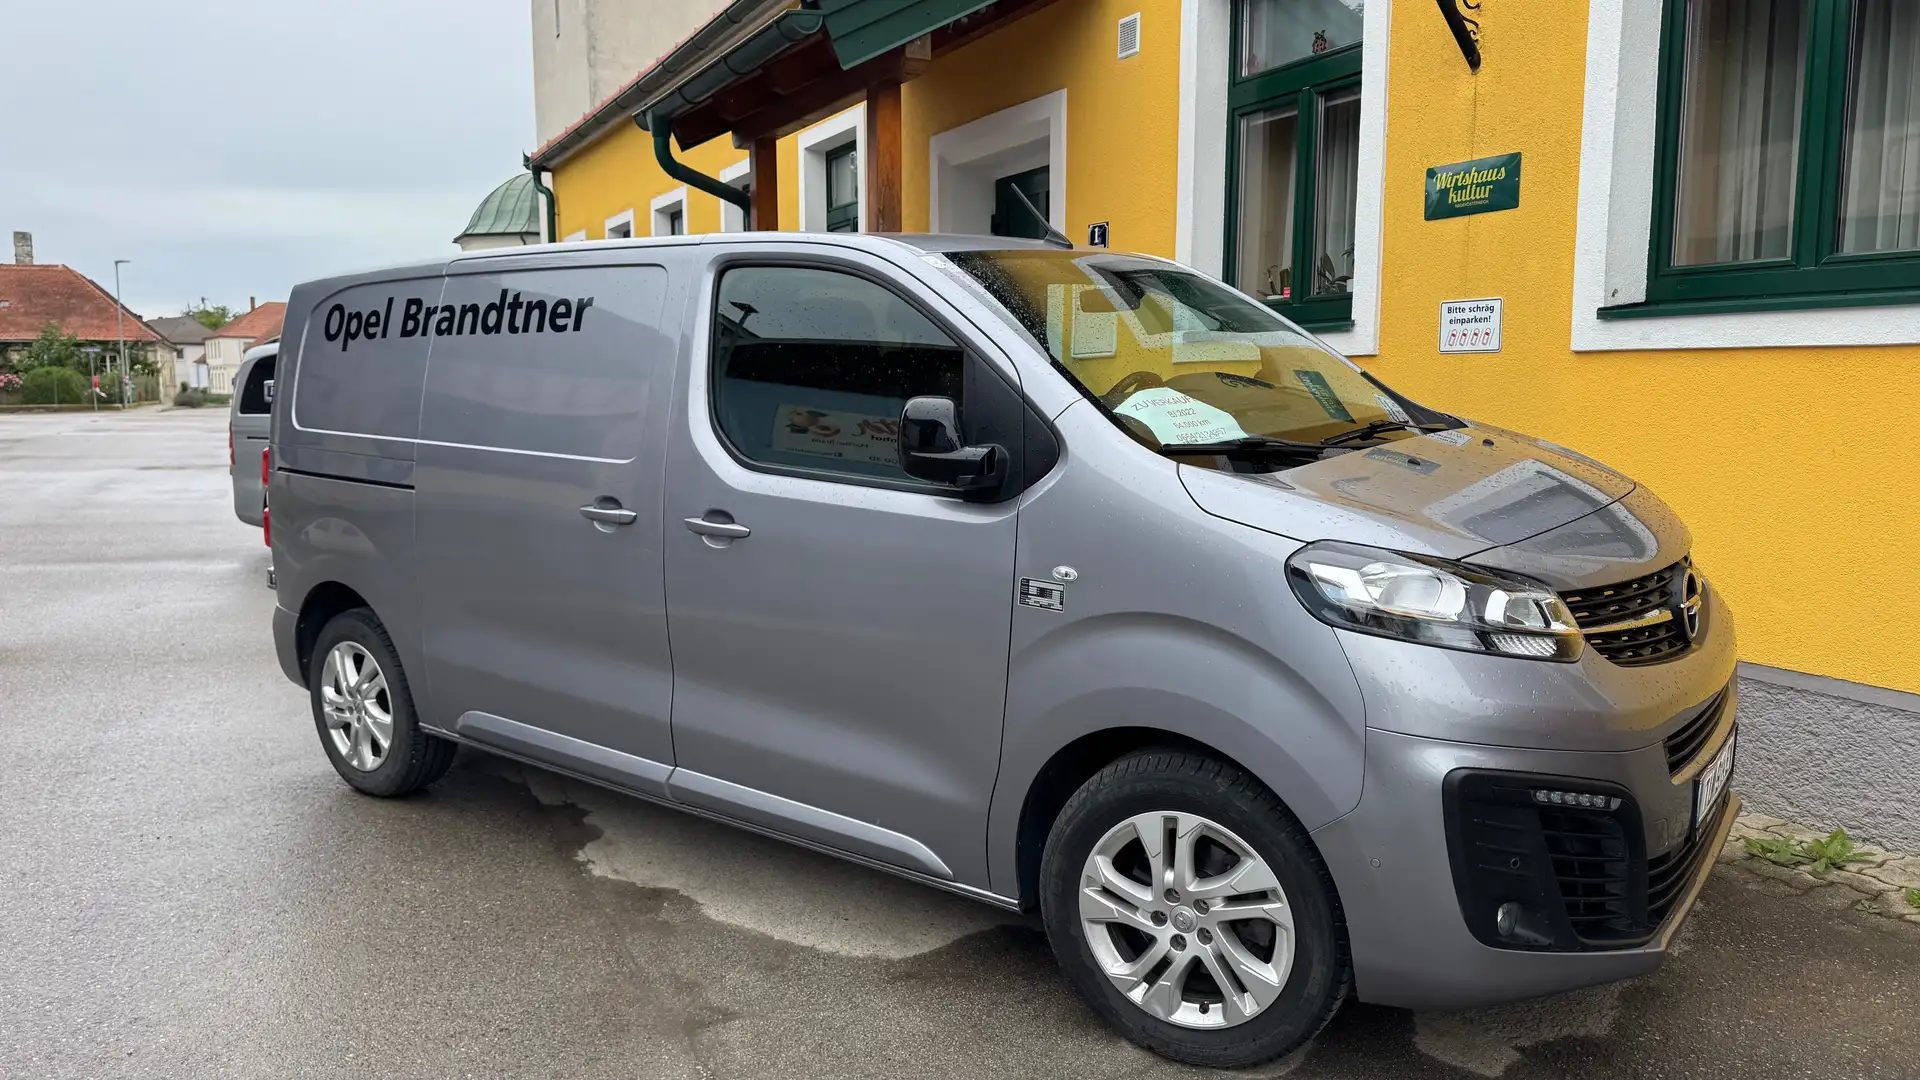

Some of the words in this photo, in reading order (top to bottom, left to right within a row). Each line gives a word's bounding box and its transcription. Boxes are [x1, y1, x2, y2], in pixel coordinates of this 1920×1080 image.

[1433, 166, 1506, 190] Wirtshaus
[1448, 184, 1493, 204] kultur
[1447, 306, 1466, 314] Bitte
[1468, 304, 1495, 314] schräg
[324, 297, 394, 352] Opel
[400, 288, 594, 338] Brandtner
[1449, 315, 1491, 326] einparken!
[1131, 400, 1149, 411] ZU
[1176, 407, 1196, 417] 2022
[1198, 419, 1211, 428] km
